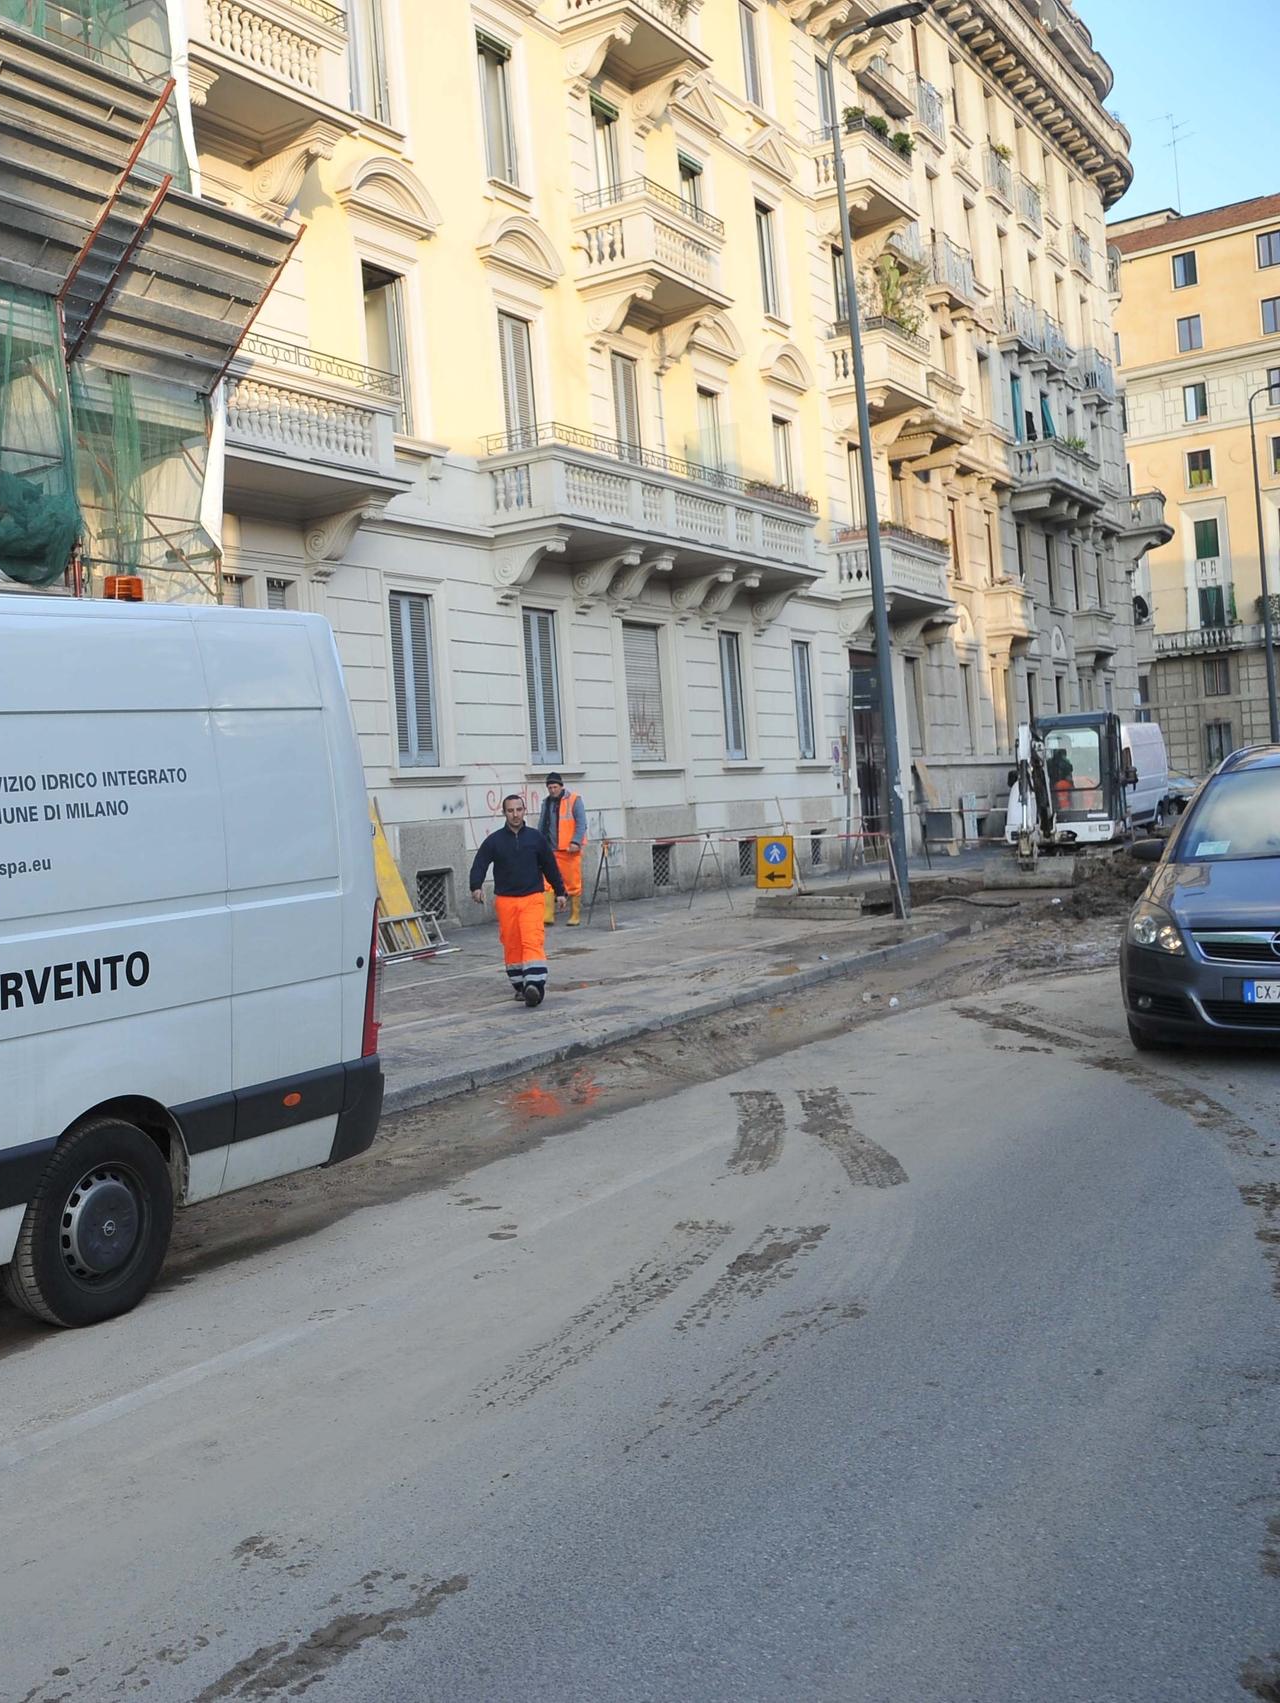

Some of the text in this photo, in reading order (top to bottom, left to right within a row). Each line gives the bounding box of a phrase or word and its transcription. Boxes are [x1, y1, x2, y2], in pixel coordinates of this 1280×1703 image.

[41, 772, 98, 791] IDRICO
[102, 767, 187, 787] INTEGRATO
[43, 804, 61, 821] DI
[65, 799, 129, 820] MILANO
